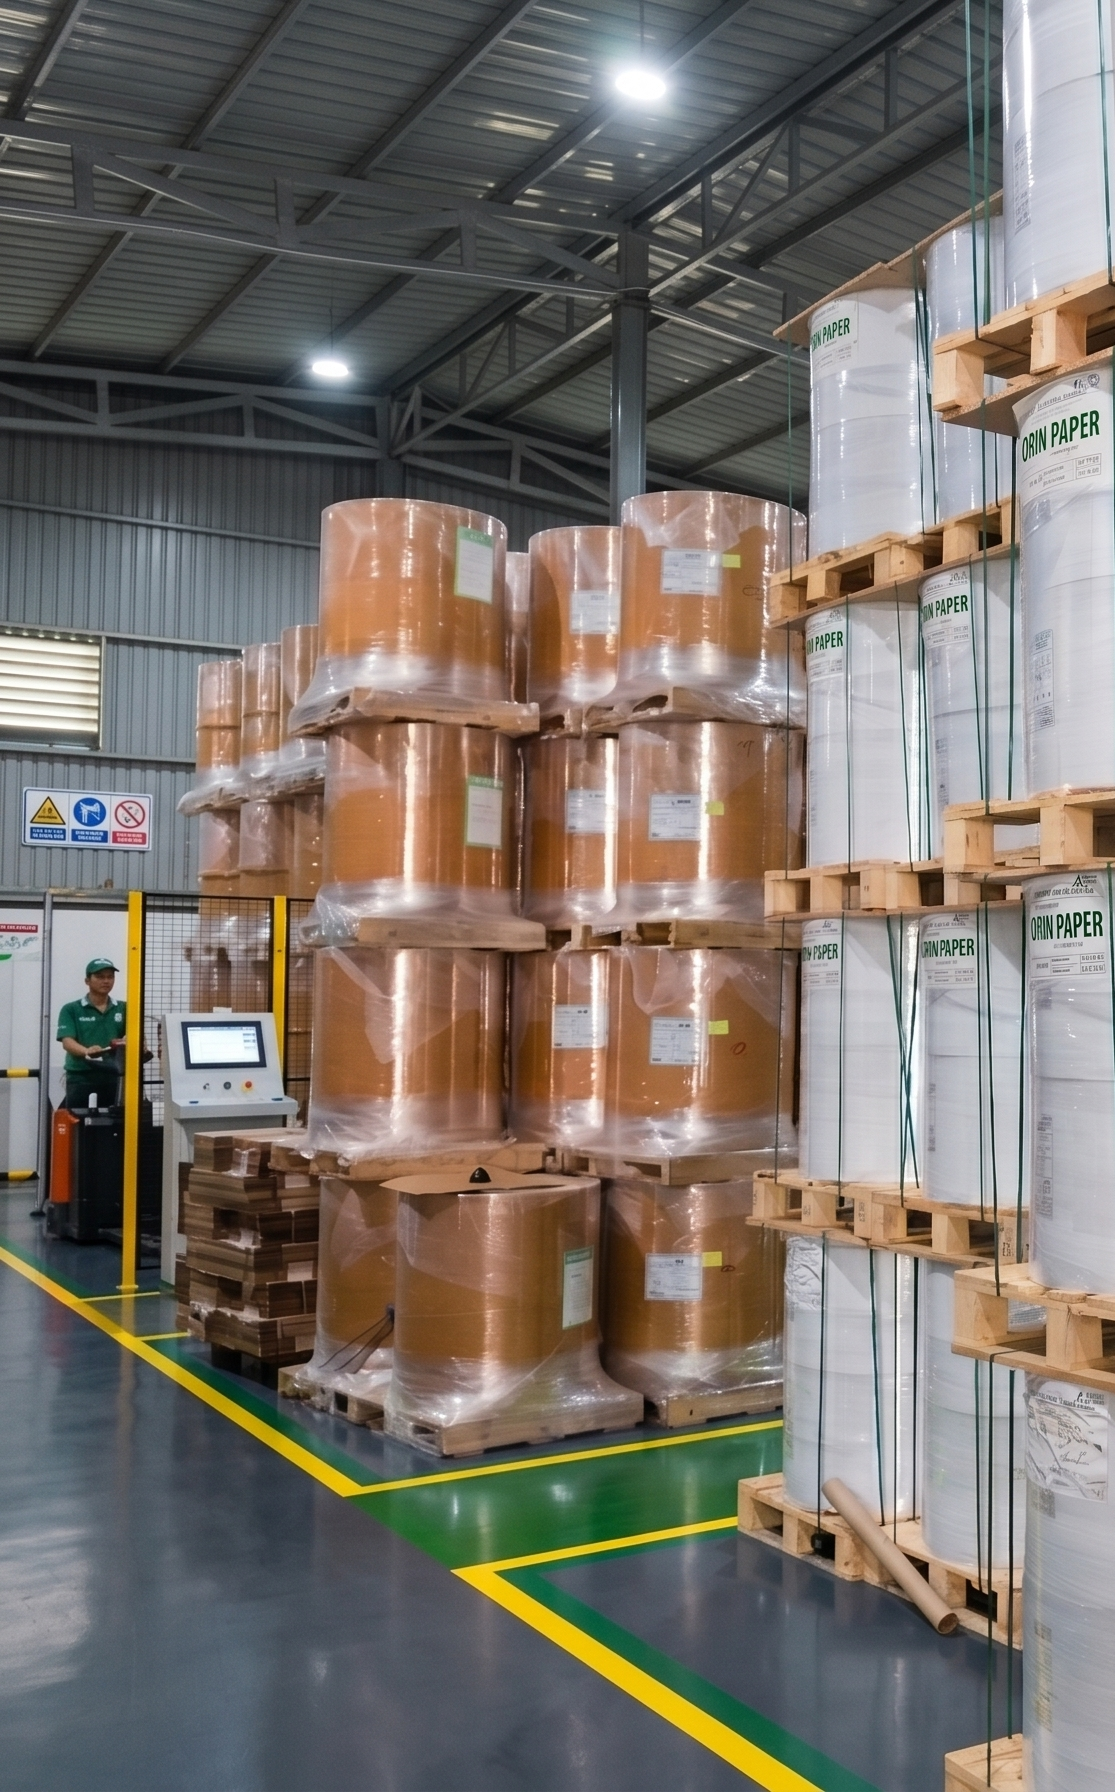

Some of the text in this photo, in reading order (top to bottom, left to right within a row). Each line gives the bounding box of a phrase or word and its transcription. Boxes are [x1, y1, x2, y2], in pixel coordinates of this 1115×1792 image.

[823, 317, 850, 344] PAPER
[1021, 410, 1100, 463] ORIN PAPER
[935, 594, 969, 618] PAPER
[815, 630, 844, 652] PAPER
[1030, 910, 1104, 941] ORIN PAPER
[940, 938, 975, 957] PAPER
